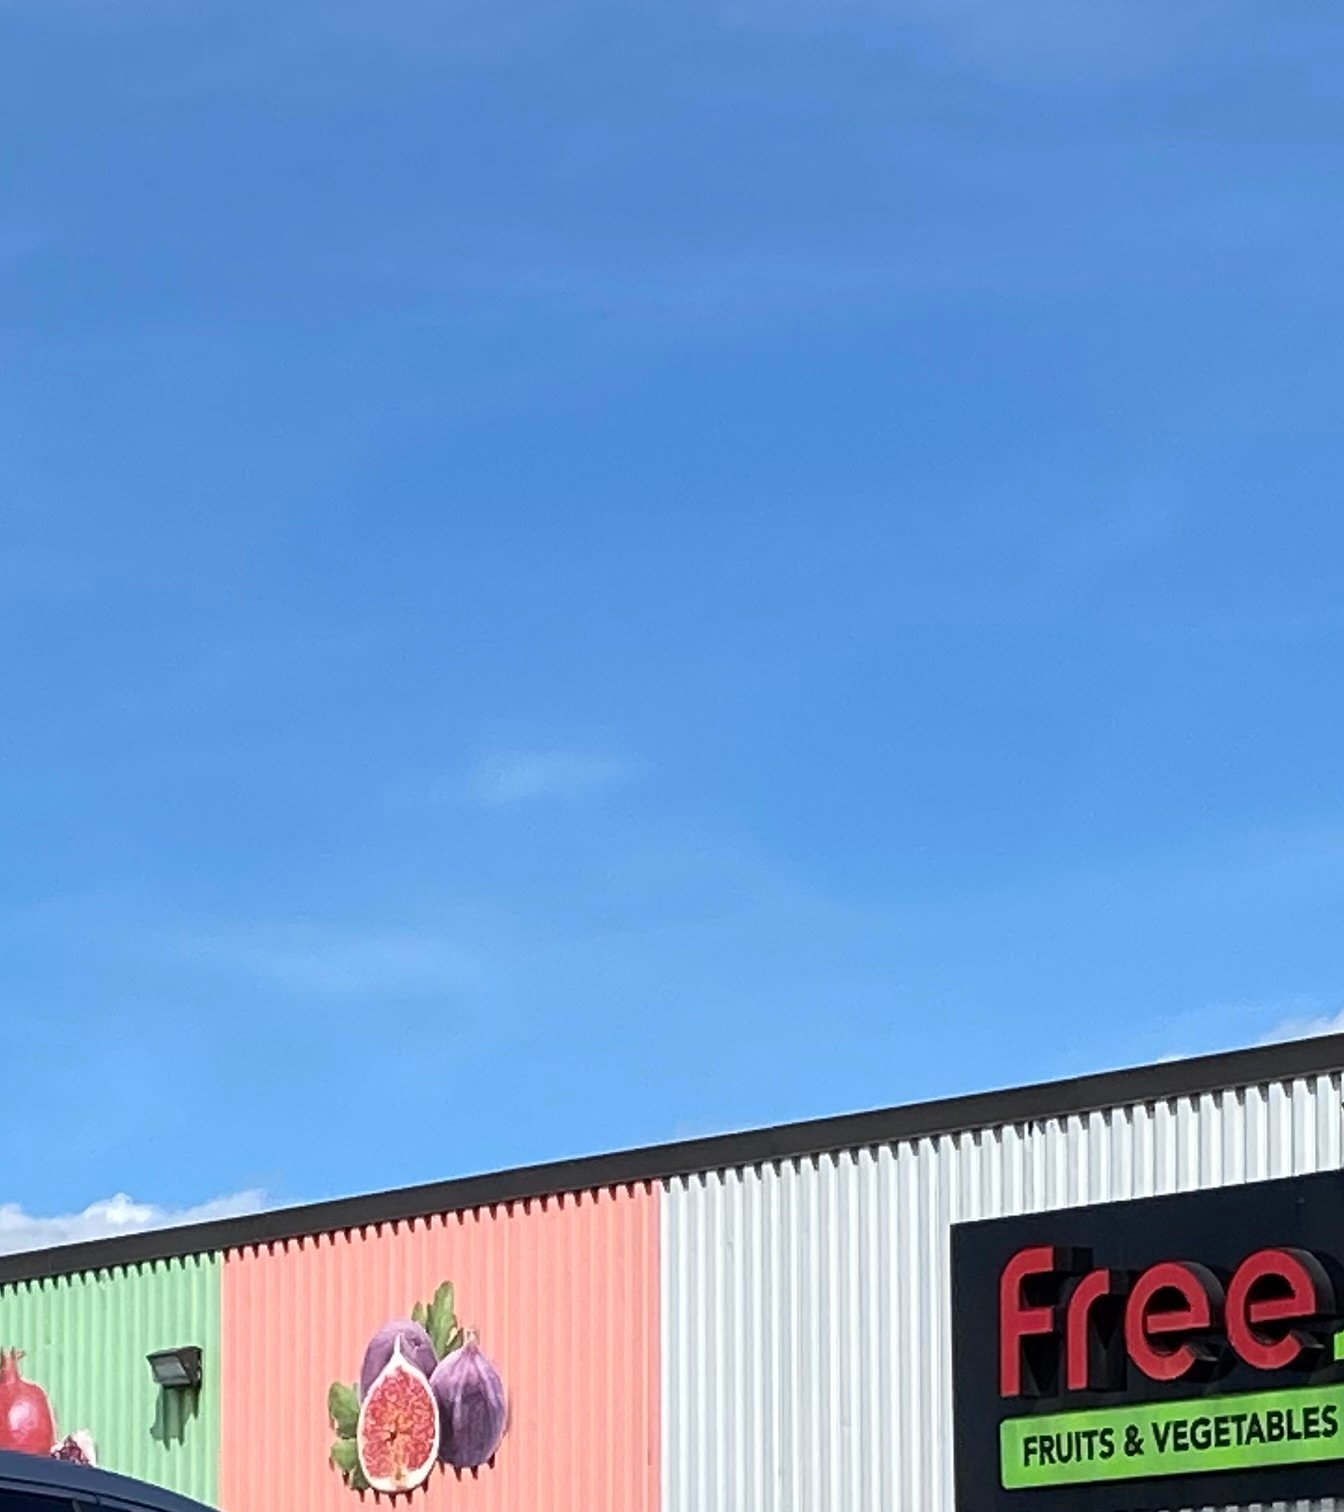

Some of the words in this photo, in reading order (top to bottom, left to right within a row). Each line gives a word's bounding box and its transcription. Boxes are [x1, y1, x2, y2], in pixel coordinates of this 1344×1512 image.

[1022, 1427, 1115, 1467] FRUITS
[1124, 1424, 1144, 1457] &
[1151, 1405, 1339, 1453] VEGETABLES
